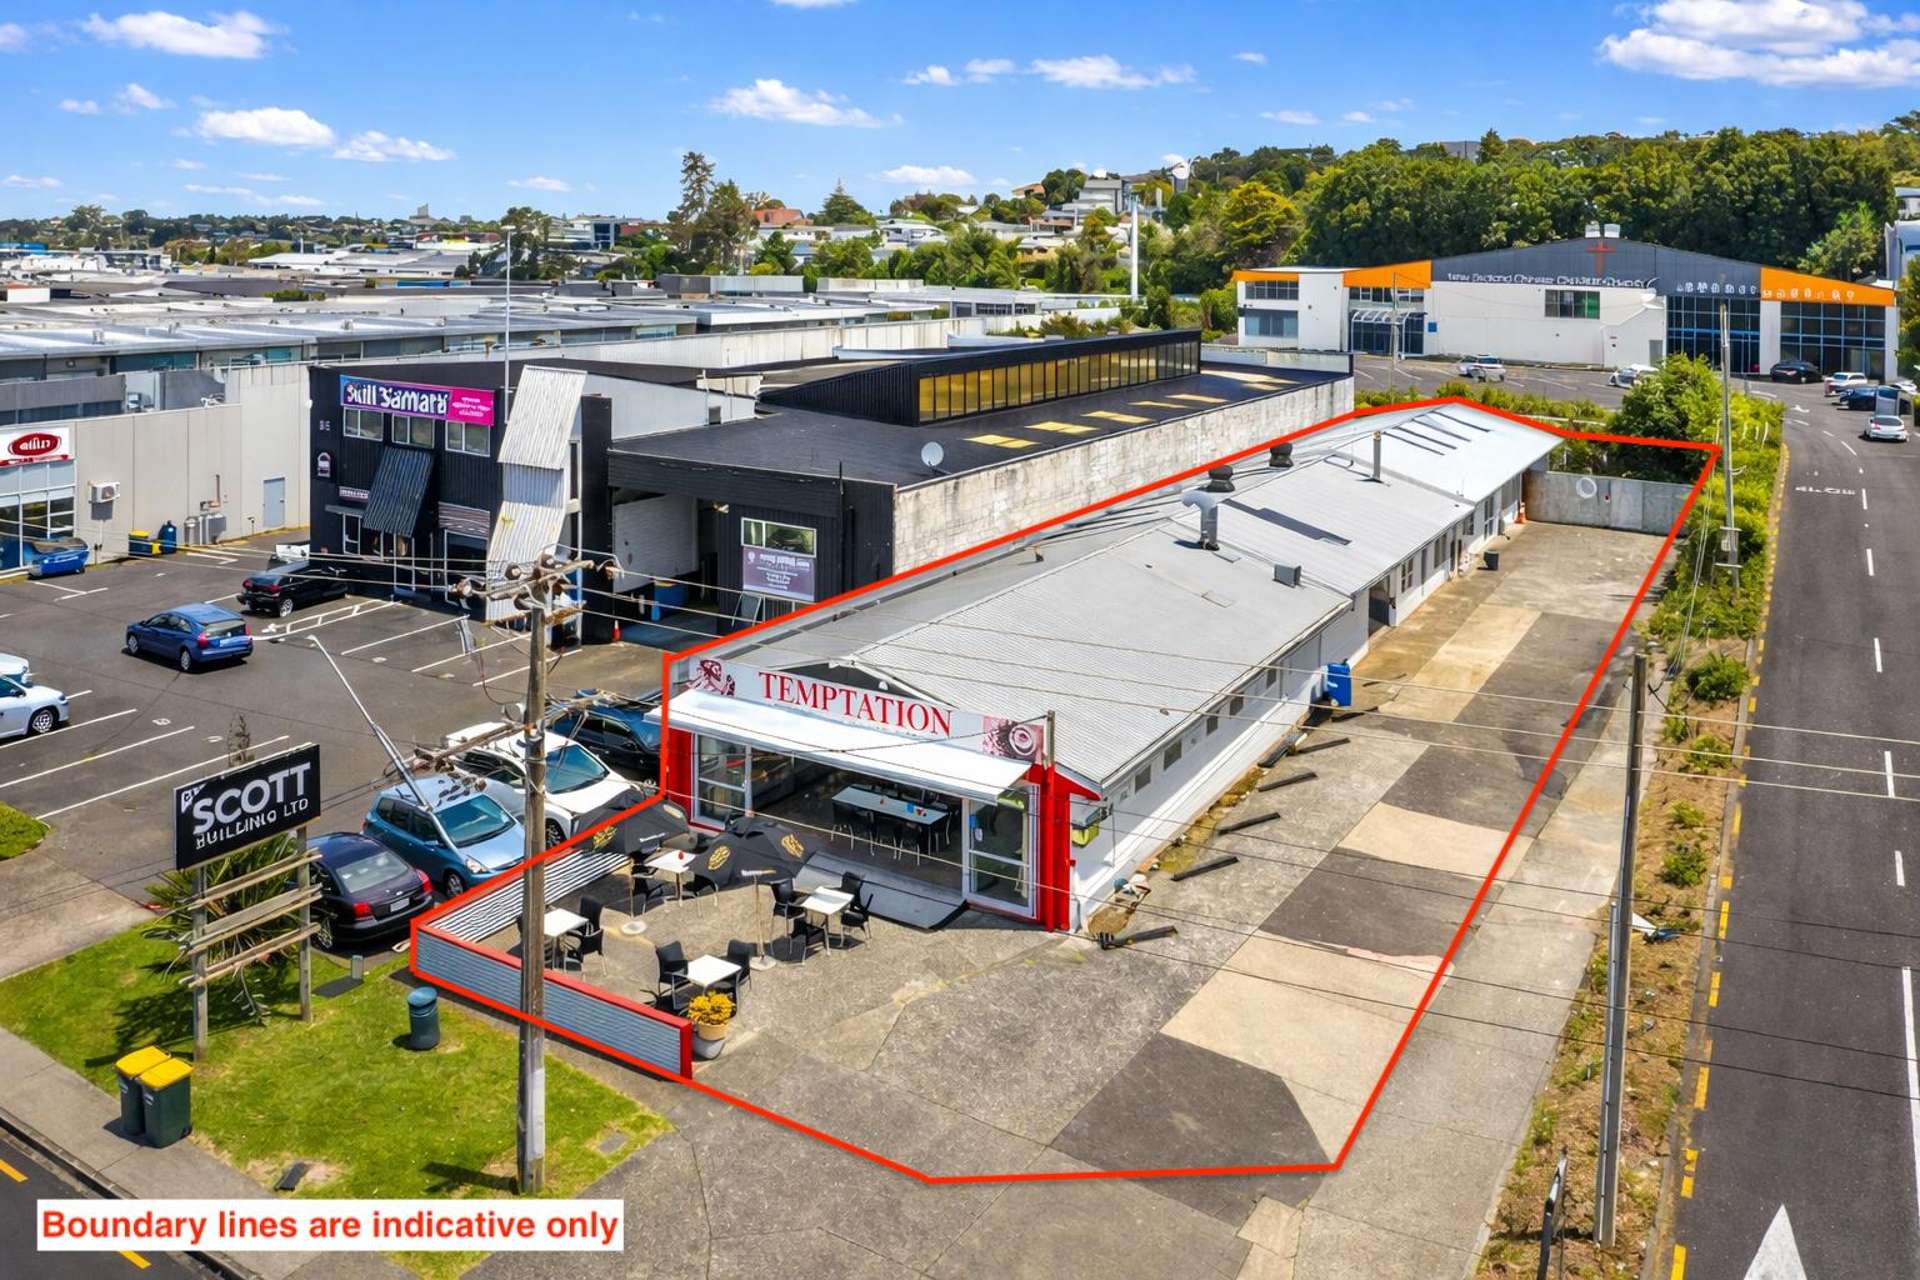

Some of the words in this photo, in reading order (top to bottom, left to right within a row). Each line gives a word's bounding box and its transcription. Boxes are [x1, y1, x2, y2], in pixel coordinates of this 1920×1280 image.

[758, 671, 951, 736] TEMPTATION
[193, 763, 311, 834] SCOTT
[283, 798, 309, 817] LTD
